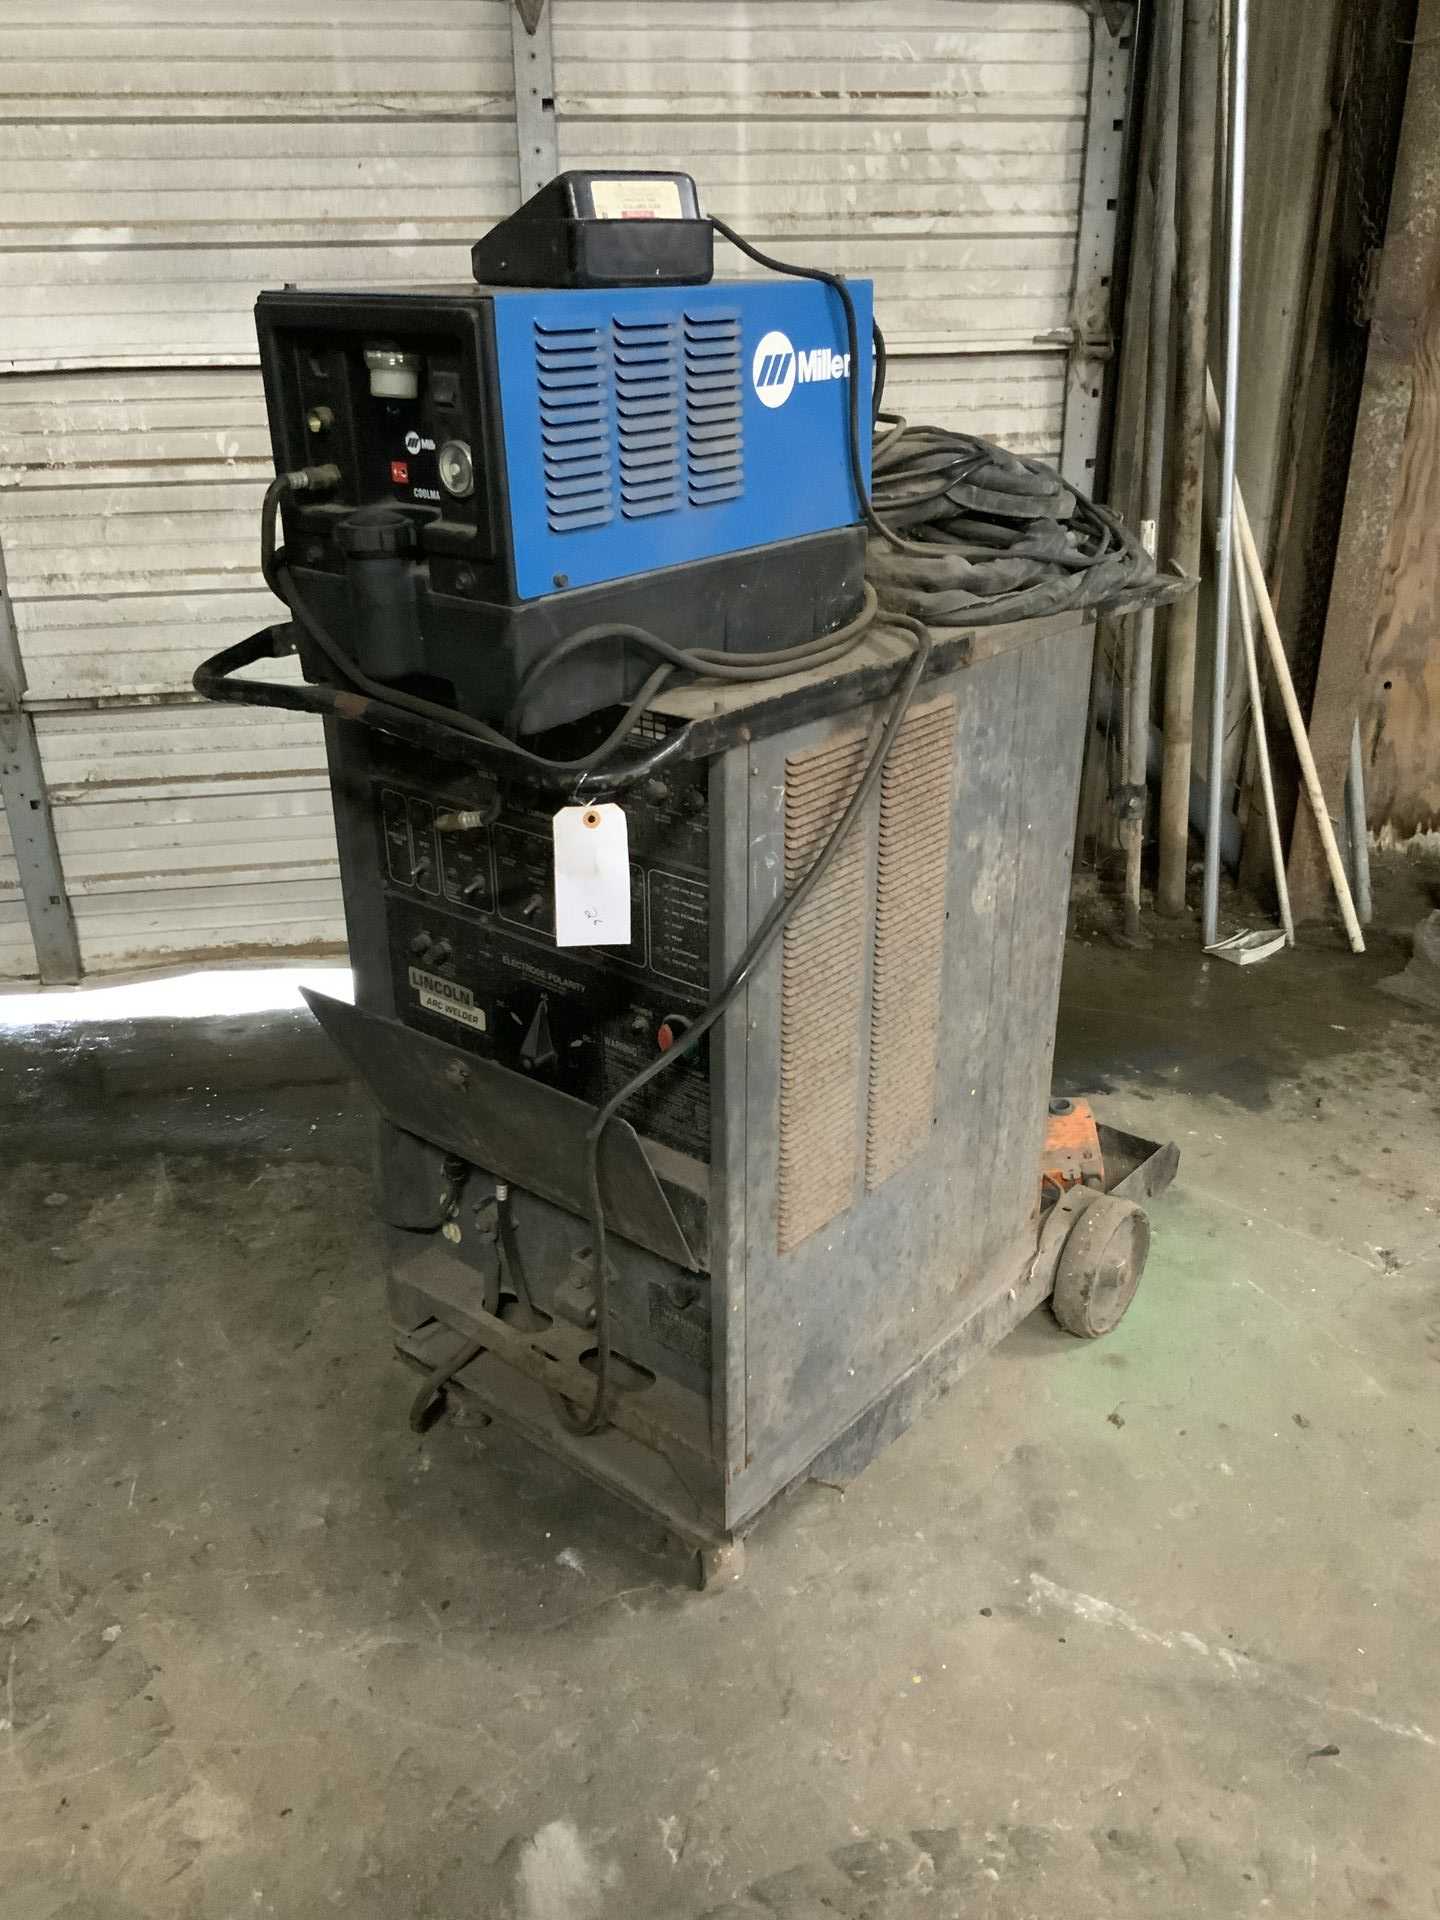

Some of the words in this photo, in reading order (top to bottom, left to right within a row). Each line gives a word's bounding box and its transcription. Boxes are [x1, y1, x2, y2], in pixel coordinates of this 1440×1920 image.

[798, 347, 850, 384] Miller
[411, 970, 471, 1006] LINCOLN
[425, 996, 443, 1010] ARC
[444, 1004, 479, 1025] WELDER
